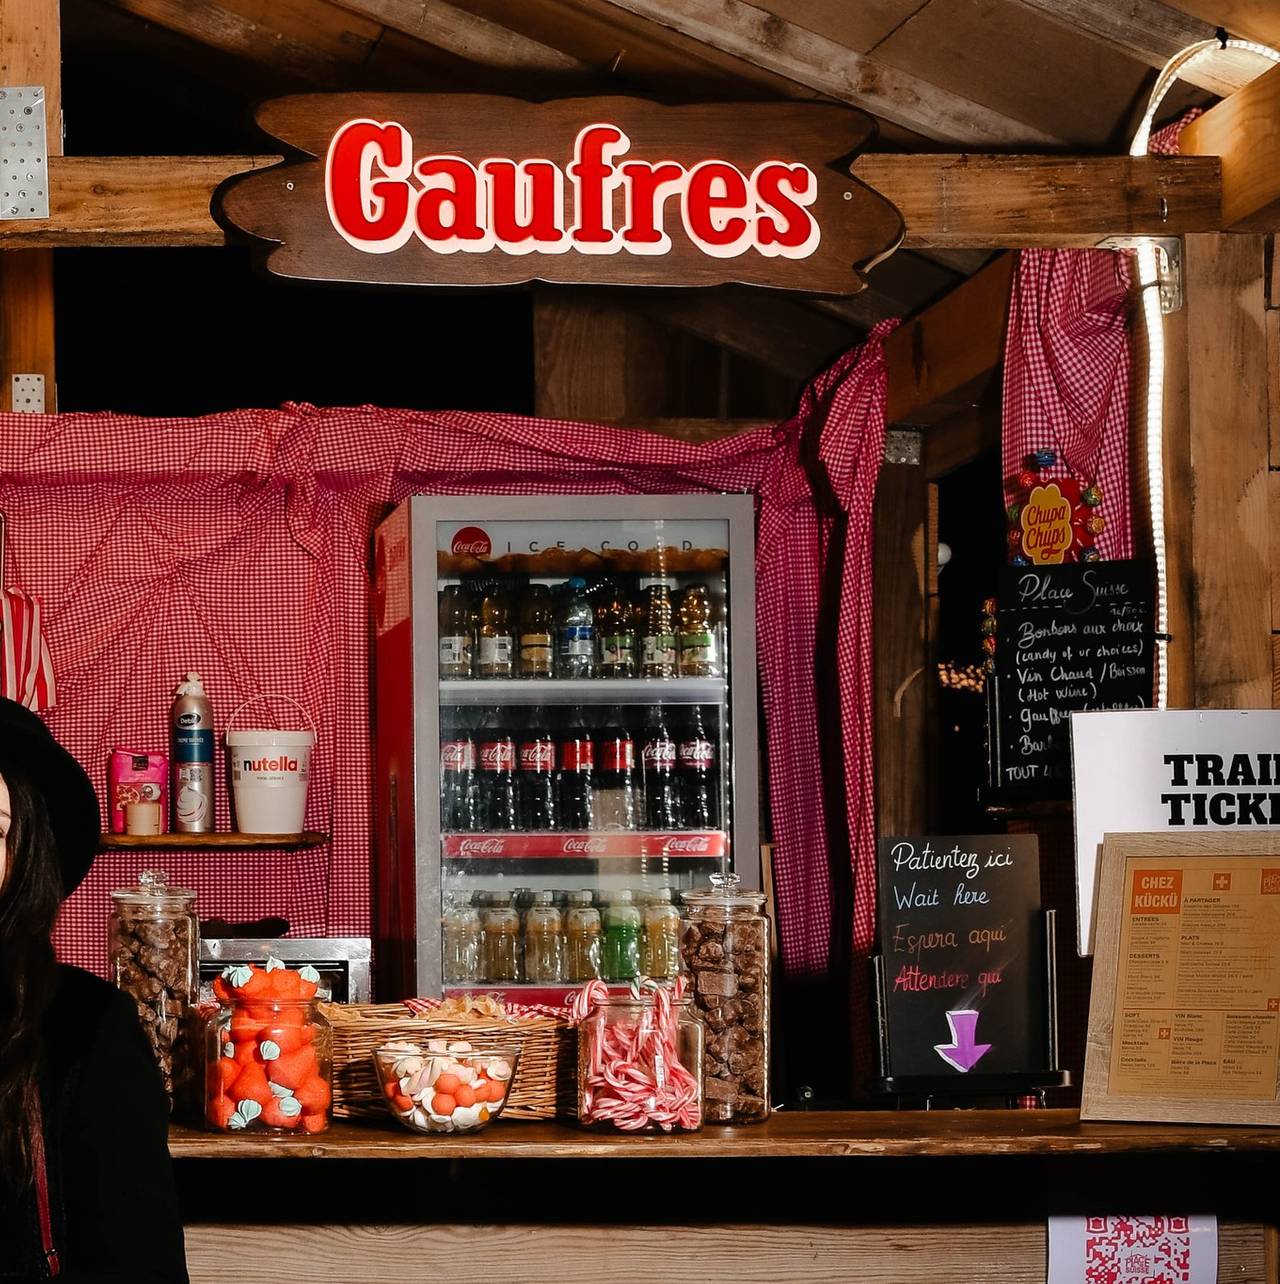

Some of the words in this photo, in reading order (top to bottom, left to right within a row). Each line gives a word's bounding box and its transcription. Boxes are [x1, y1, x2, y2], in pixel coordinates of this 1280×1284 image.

[324, 117, 820, 259] Gaufres
[1027, 505, 1066, 528] Chupa
[507, 541, 566, 553] ICE
[600, 540, 693, 552] COD
[1027, 526, 1065, 560] Chups
[1019, 574, 1073, 602] Place
[1073, 570, 1129, 607] Suisse
[1018, 620, 1077, 649] Bonbons
[1083, 624, 1106, 634] aux
[1016, 646, 1056, 665] (candy
[1062, 646, 1073, 661] of
[1080, 648, 1091, 657] ur
[1017, 667, 1043, 684] Vin
[1050, 666, 1094, 681] Chaud
[243, 756, 298, 771] nutella
[1006, 764, 1039, 781] TOUT
[1163, 754, 1280, 786] TRAI
[891, 842, 980, 879] Patientez
[984, 847, 1013, 868] ici
[1141, 876, 1175, 889] CHEZ
[894, 882, 939, 910] Wait
[953, 882, 990, 906] here
[1135, 892, 1179, 908] KÜCKÜ
[892, 923, 958, 962] Espera
[969, 925, 1006, 953] aqui
[893, 965, 969, 993] Attendere
[978, 968, 1002, 998] qui
[1125, 1266, 1150, 1275] SUISSE
